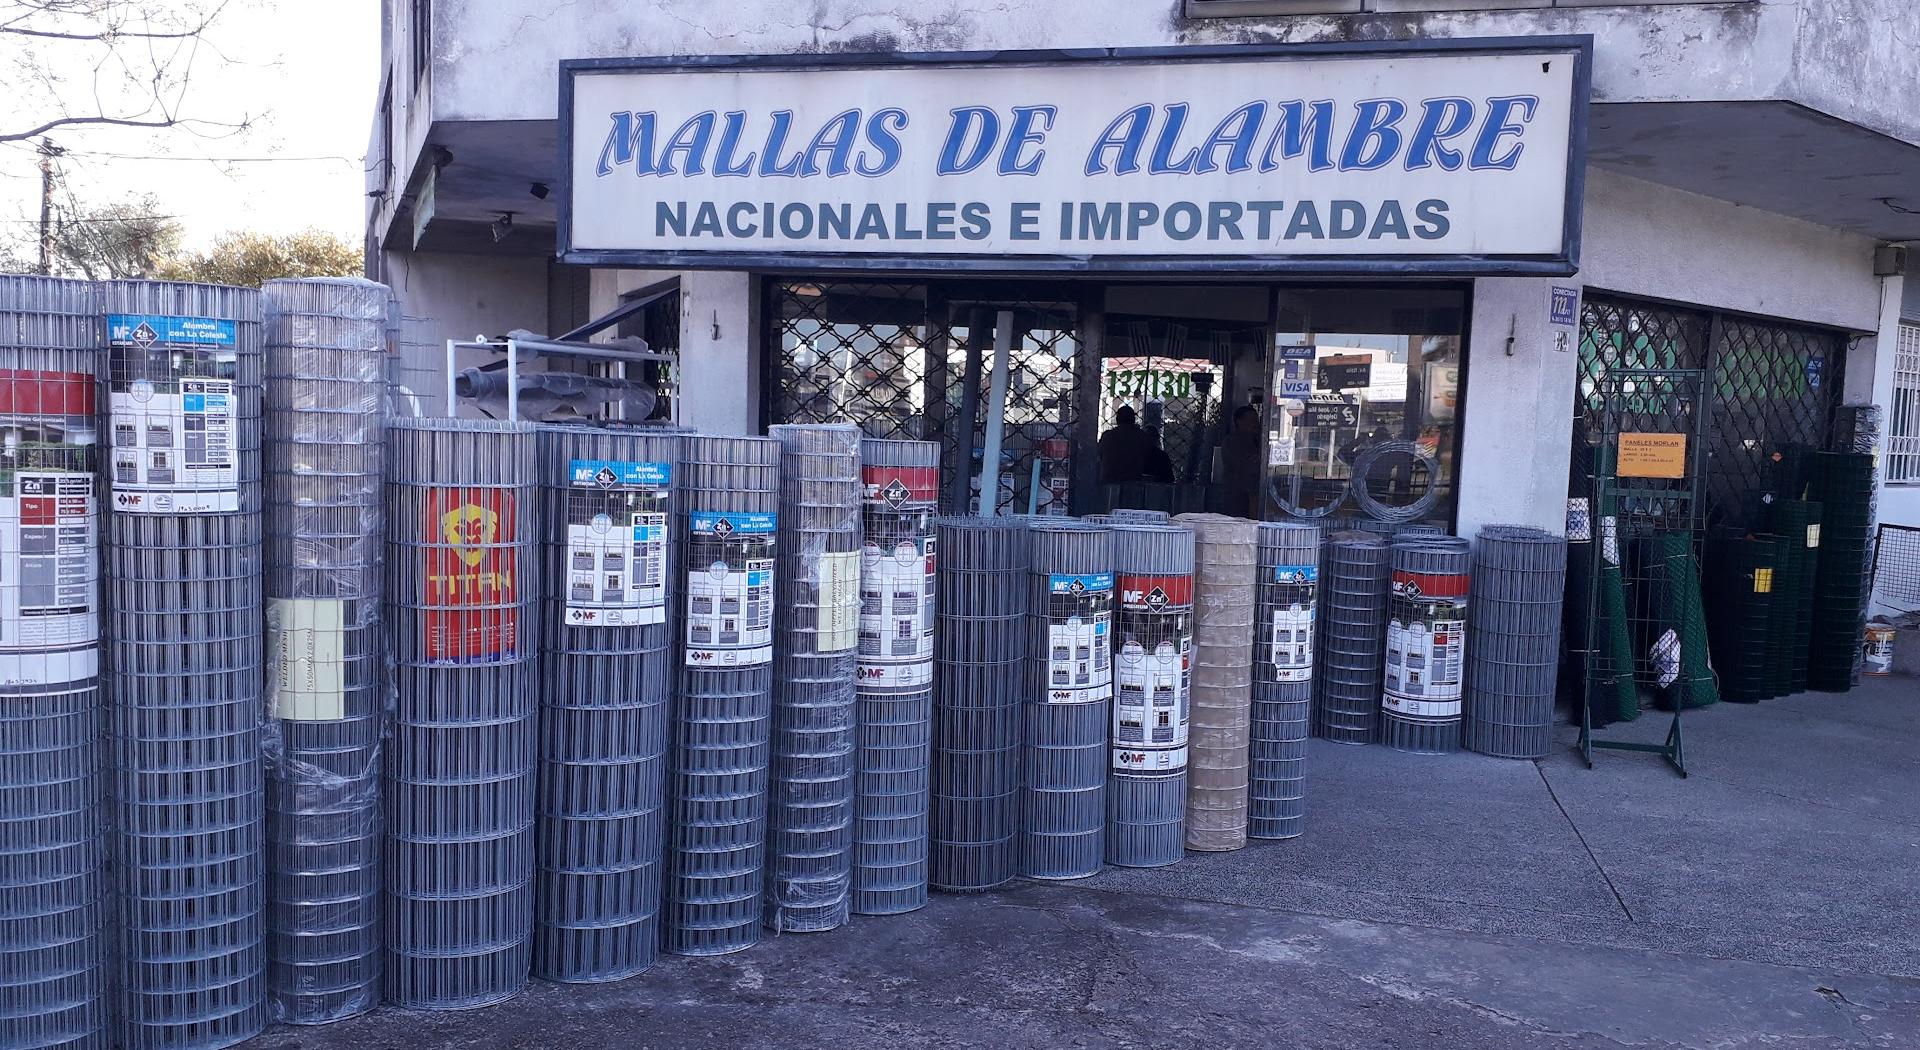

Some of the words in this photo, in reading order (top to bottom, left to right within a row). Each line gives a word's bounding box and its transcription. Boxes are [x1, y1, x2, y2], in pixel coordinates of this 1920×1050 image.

[596, 106, 909, 178] MALLAS
[936, 104, 1058, 177] DE
[1084, 94, 1540, 177] ALAMBRE
[655, 201, 992, 240] NACIONALES
[1010, 202, 1040, 240] E
[1061, 198, 1450, 241] IMPORTADAS
[1283, 382, 1310, 392] VISA
[429, 569, 512, 596] TITAN
[1123, 589, 1144, 603] MF
[867, 668, 885, 679] MF
[1131, 753, 1146, 763] MF
